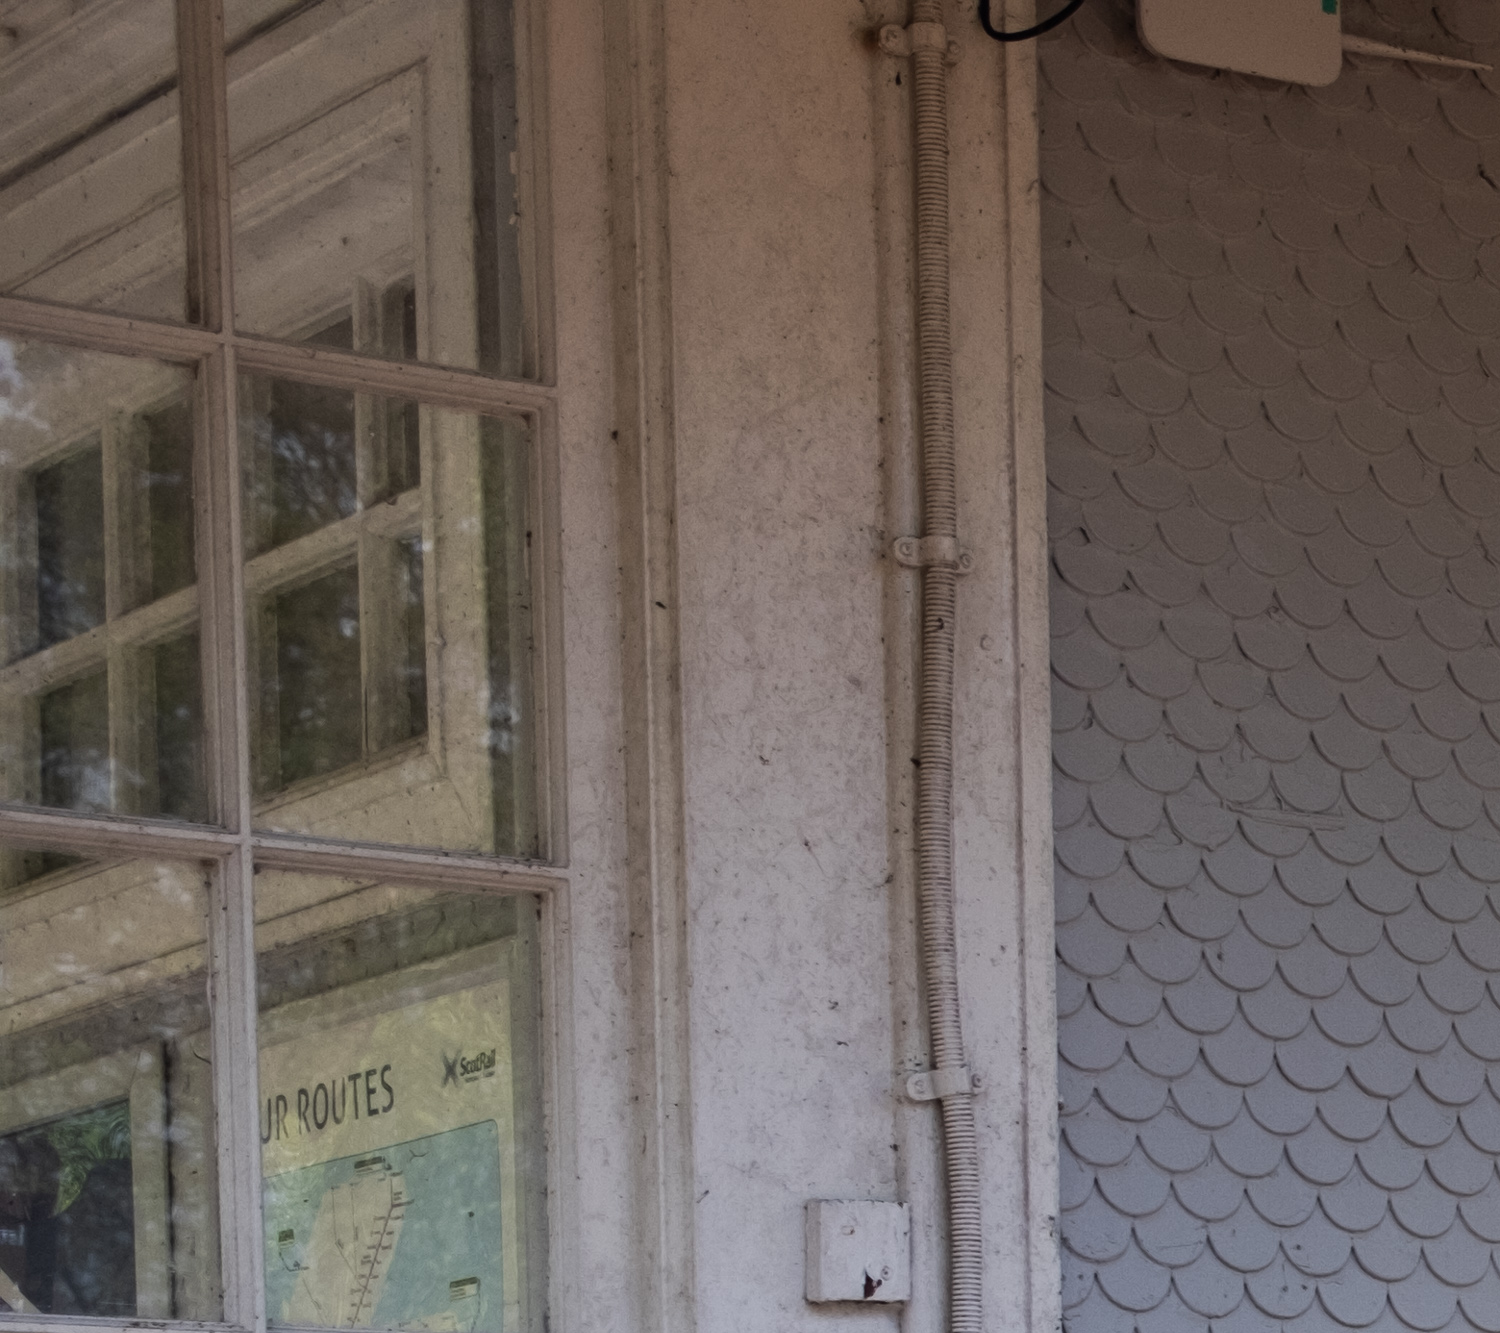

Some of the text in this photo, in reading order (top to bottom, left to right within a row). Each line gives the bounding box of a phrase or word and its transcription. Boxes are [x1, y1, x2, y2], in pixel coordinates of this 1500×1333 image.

[460, 1048, 496, 1077] ScotRail
[260, 1064, 394, 1144] UR ROUTES
